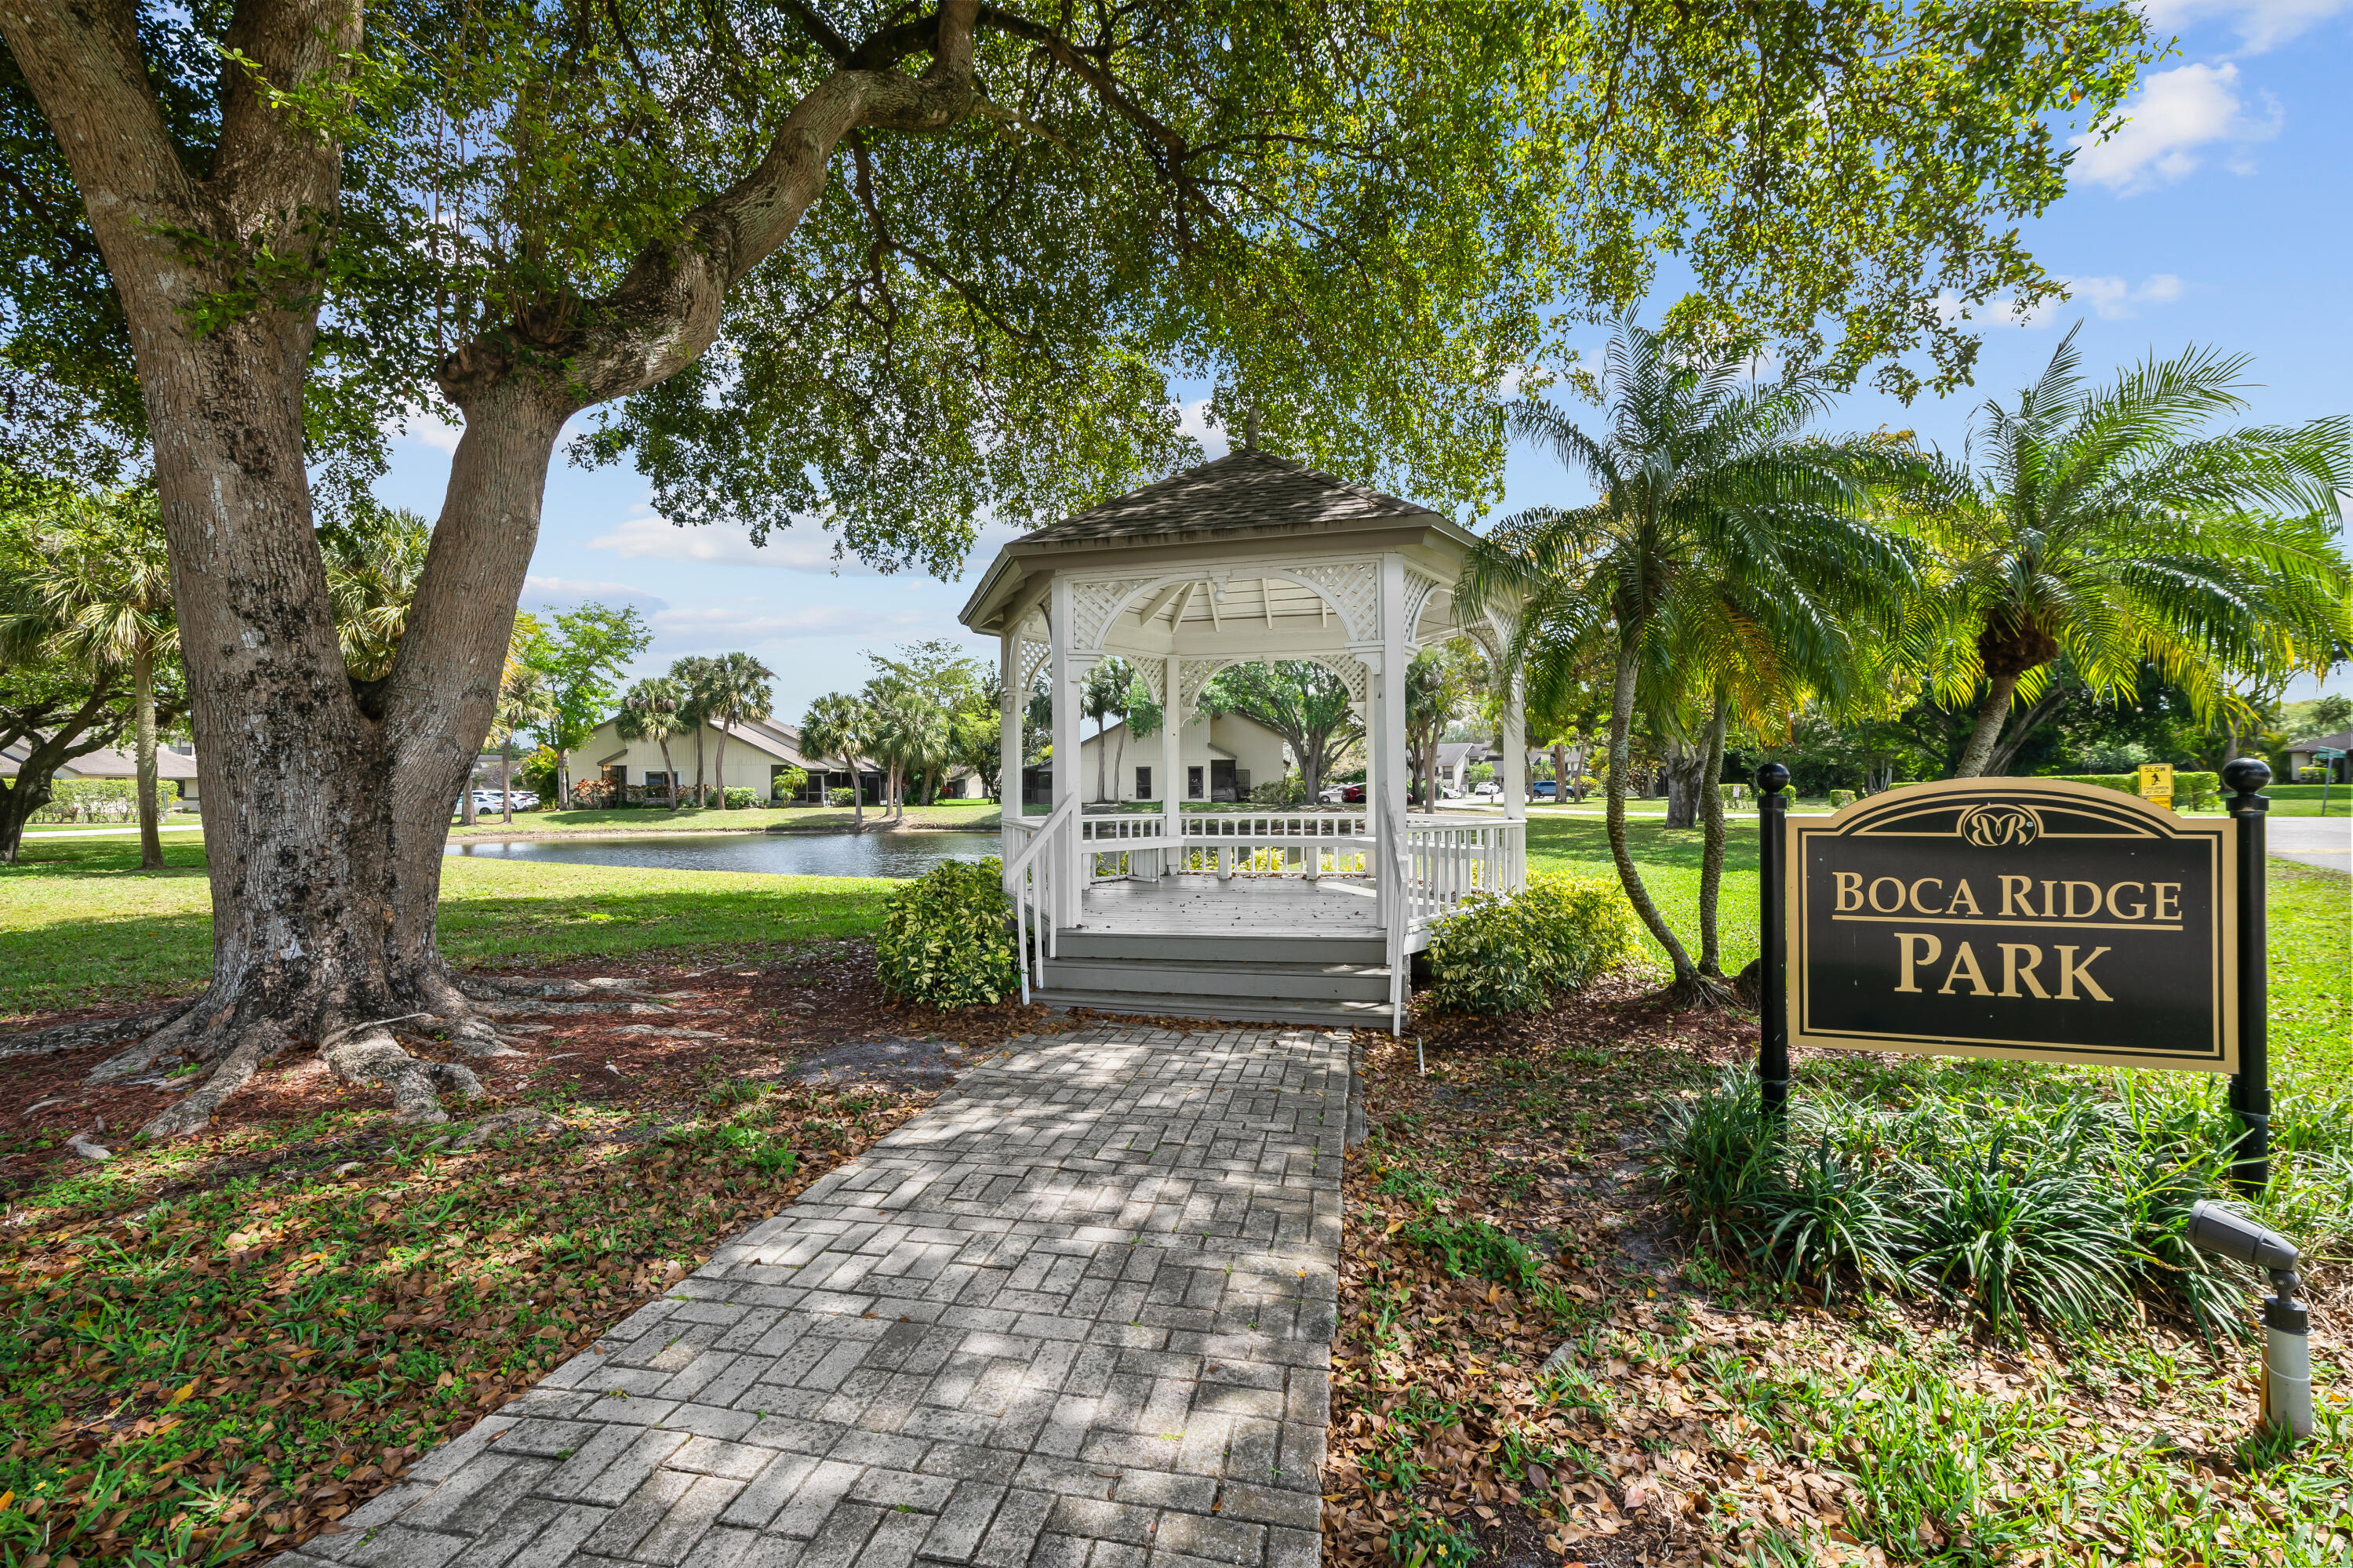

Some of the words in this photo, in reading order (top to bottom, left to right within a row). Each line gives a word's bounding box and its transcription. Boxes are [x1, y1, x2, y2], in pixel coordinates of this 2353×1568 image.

[1831, 871, 1984, 915] BOCA
[1997, 875, 2184, 921] RIDGE
[1893, 932, 2115, 1002] PARK
